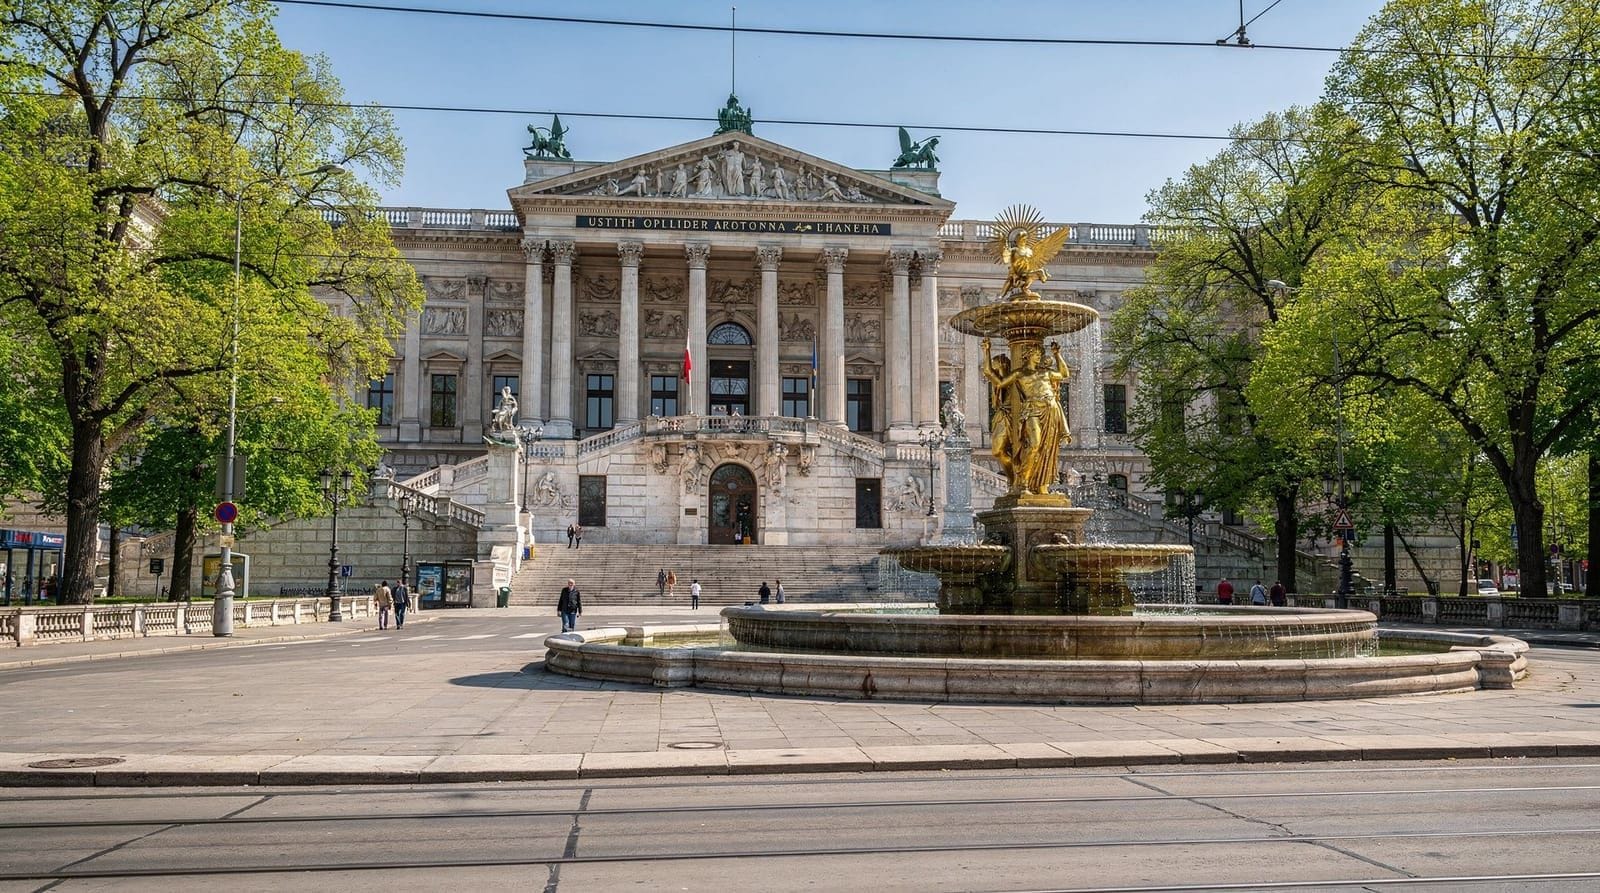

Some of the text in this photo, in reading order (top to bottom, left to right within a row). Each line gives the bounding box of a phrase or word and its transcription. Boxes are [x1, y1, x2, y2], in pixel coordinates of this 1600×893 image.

[588, 217, 635, 228] USTITH
[643, 218, 708, 230] OPLLIDER
[714, 219, 785, 231] AROTONNA
